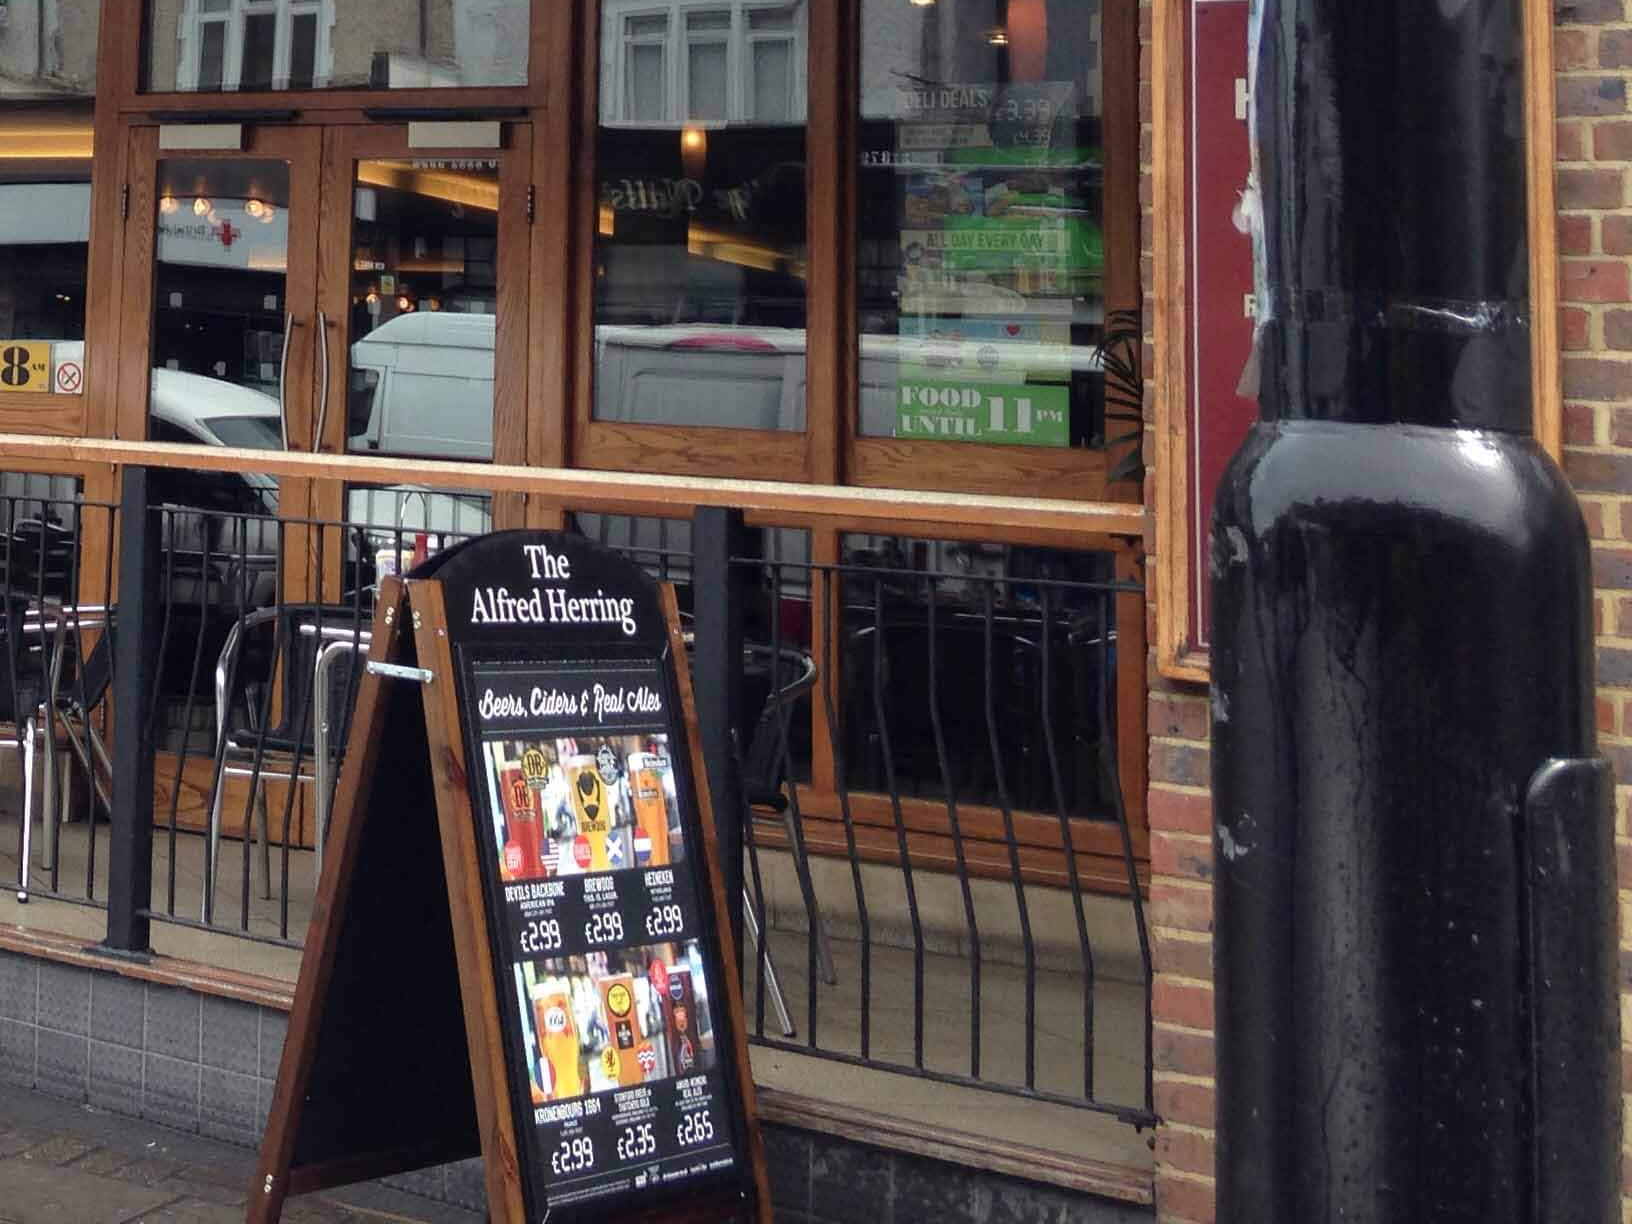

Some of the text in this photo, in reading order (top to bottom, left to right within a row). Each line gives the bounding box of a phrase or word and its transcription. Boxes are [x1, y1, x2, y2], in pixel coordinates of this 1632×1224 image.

[904, 87, 990, 111] DELI DEALS
[951, 232, 979, 250] DAY
[979, 232, 1019, 249] EVERY
[1020, 232, 1044, 249] DAY
[1, 345, 31, 387] 8
[901, 385, 982, 409] FOOD
[901, 396, 1064, 437] UNTIL 11 PM
[523, 544, 571, 579] The
[471, 587, 637, 635] Alfred Herring
[478, 688, 528, 720] Beers,
[530, 686, 578, 717] Ciders
[593, 683, 625, 723] Real
[626, 686, 662, 713] Ales
[531, 880, 566, 899] BACKBONE
[583, 875, 615, 894] BREWDOG
[520, 919, 562, 953] £2.99
[584, 911, 625, 944] £2.99
[645, 904, 684, 937] £2.99
[617, 1123, 656, 1160] £2.35
[677, 1110, 715, 1146] £2.65
[552, 1136, 595, 1175] £2.99
